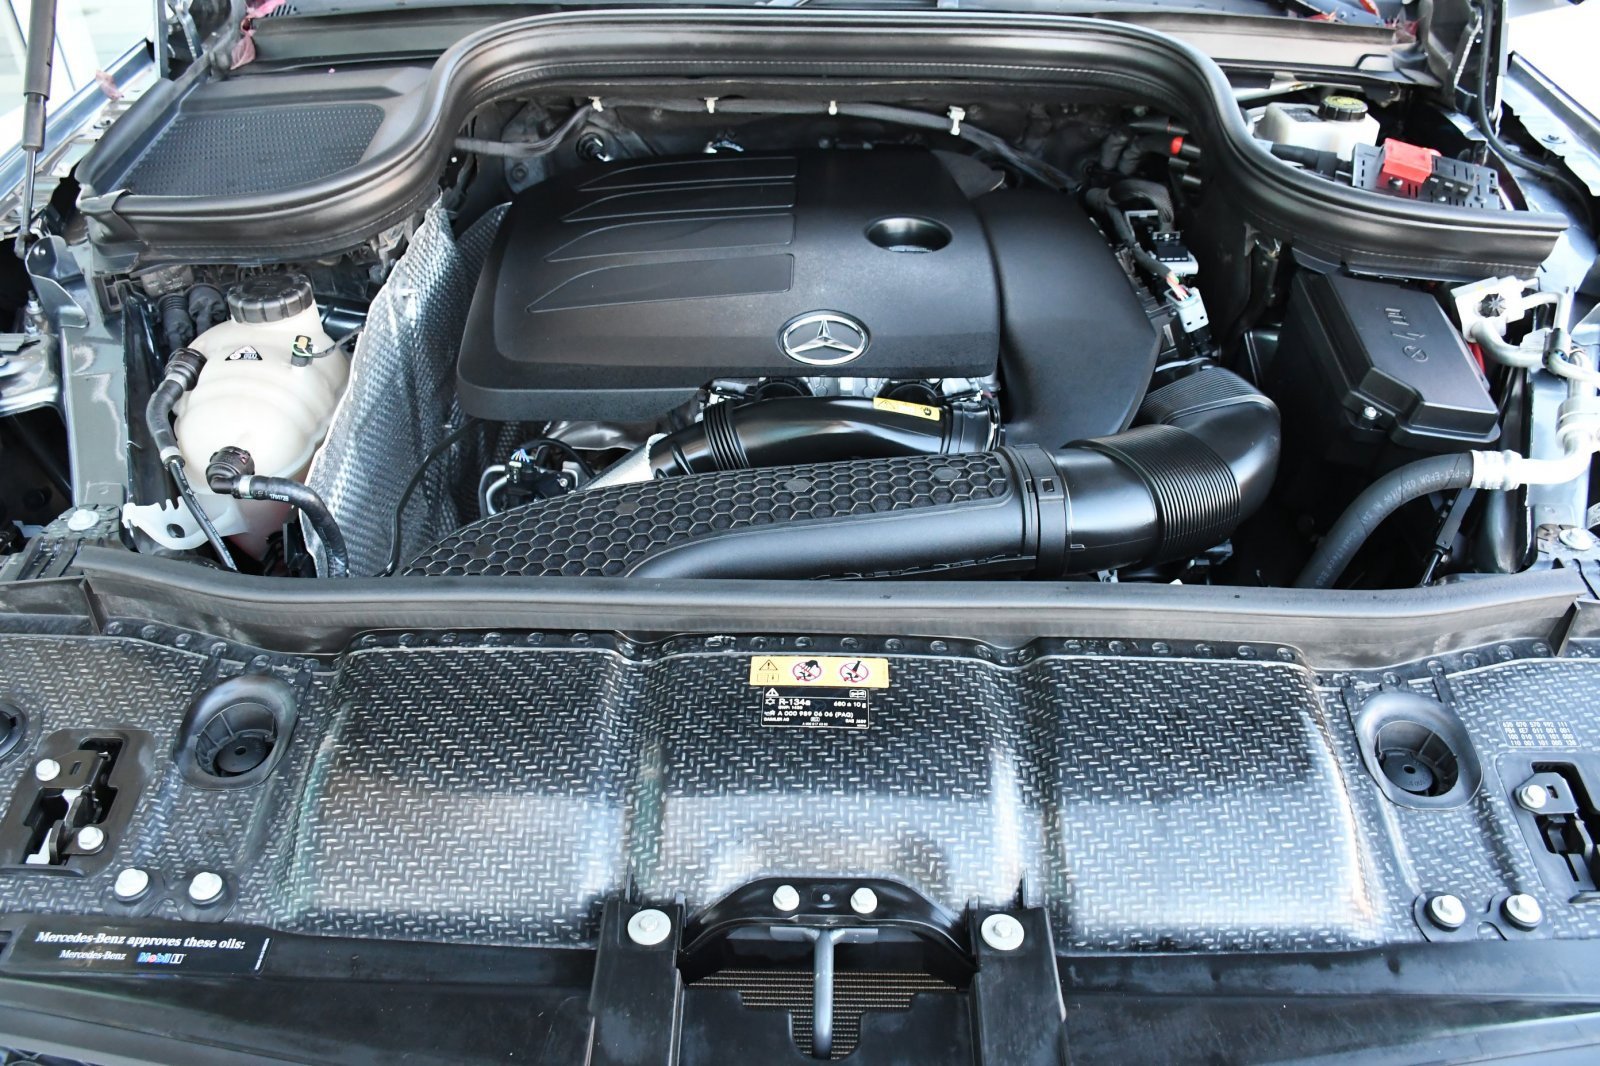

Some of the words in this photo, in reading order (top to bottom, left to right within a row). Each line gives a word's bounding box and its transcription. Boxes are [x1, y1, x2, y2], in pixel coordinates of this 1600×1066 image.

[779, 698, 811, 706] R-134a
[36, 931, 126, 945] Mercedes-Benz
[126, 936, 182, 948] approves
[183, 937, 219, 948] these
[218, 938, 246, 950] oils:
[59, 949, 127, 961] Mercedes-Benz
